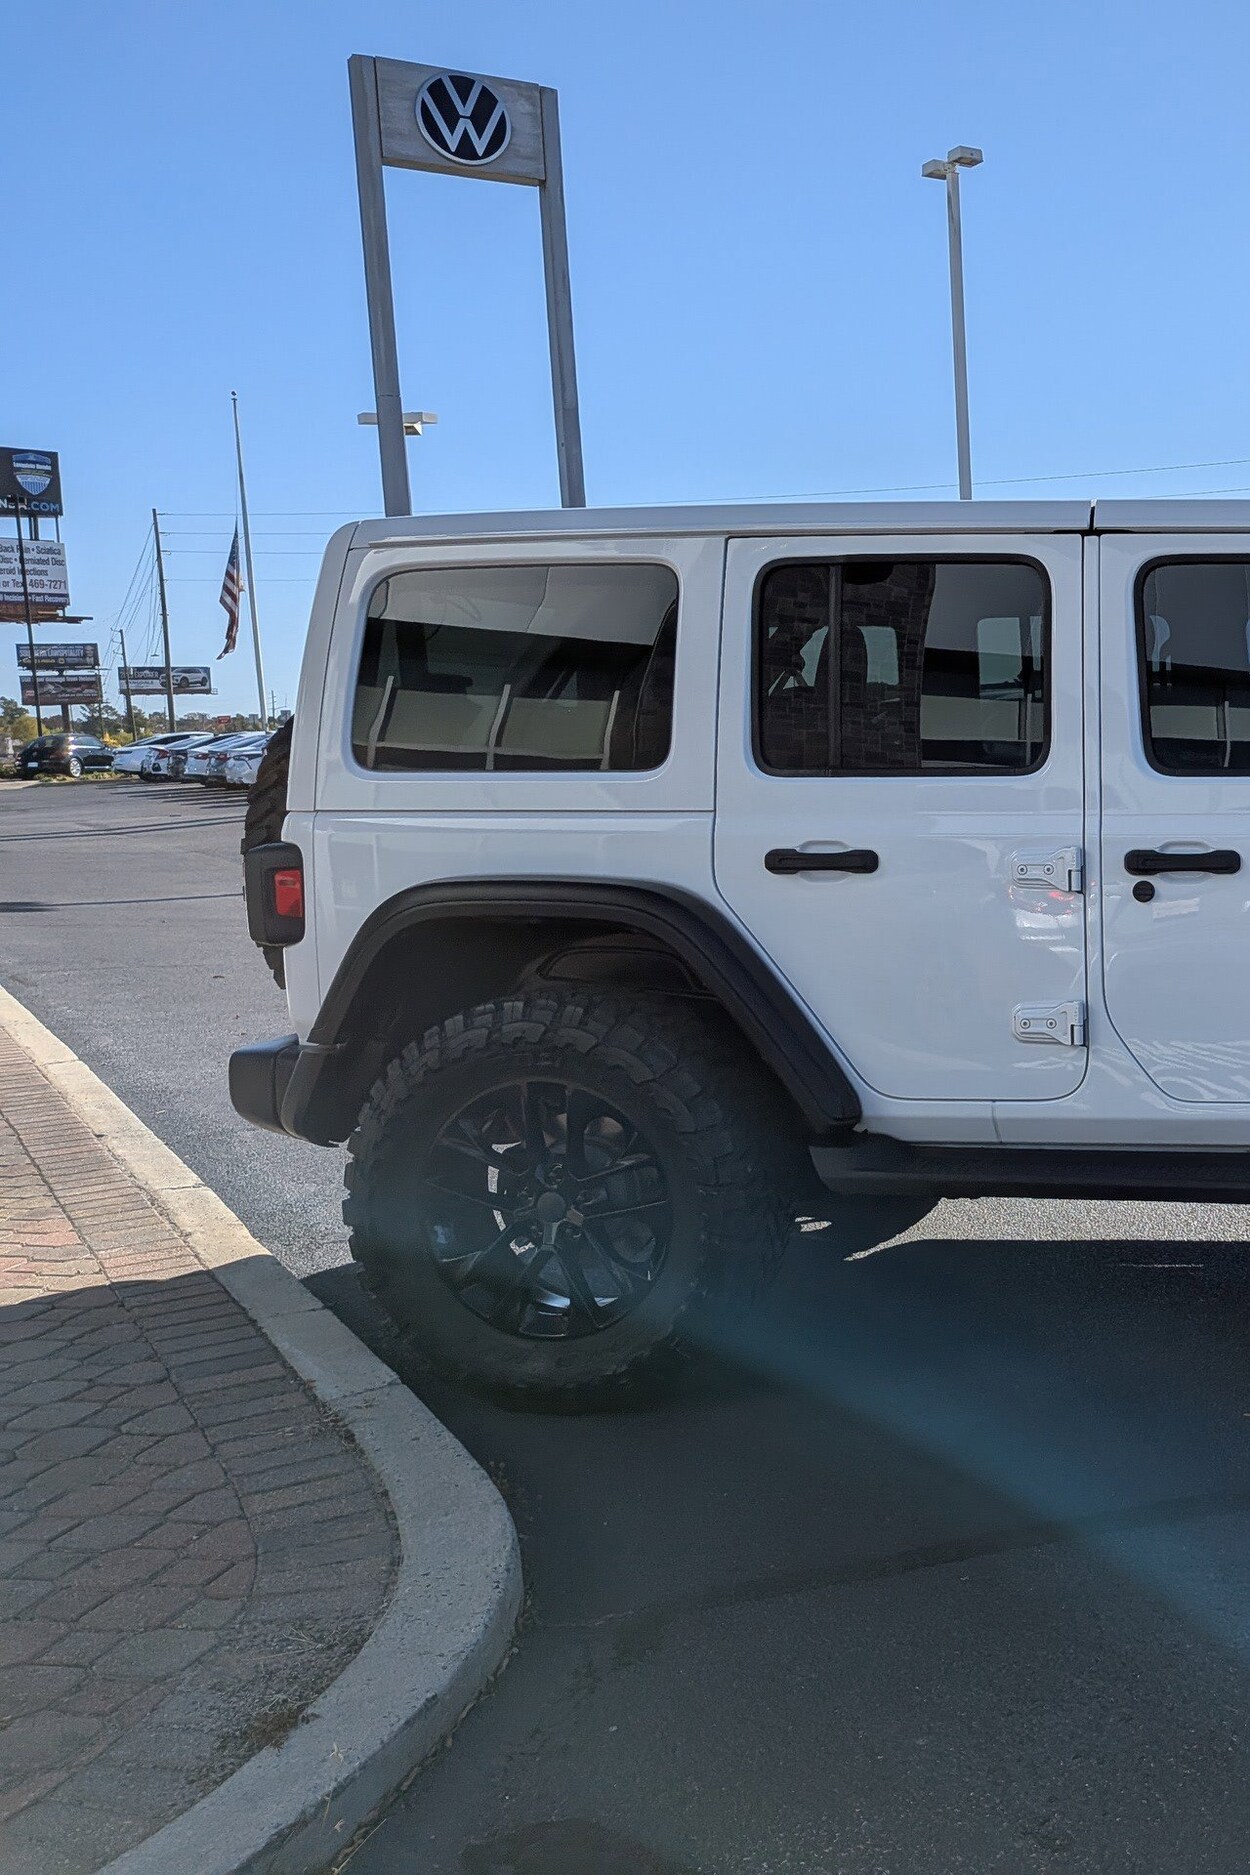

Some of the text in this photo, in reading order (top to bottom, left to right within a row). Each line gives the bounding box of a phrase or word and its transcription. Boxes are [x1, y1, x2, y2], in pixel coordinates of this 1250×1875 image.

[16, 545, 31, 554] Pin
[36, 545, 61, 556] Sciatica
[21, 556, 50, 566] erniated
[12, 579, 27, 588] Tex
[29, 579, 67, 590] 469-7271
